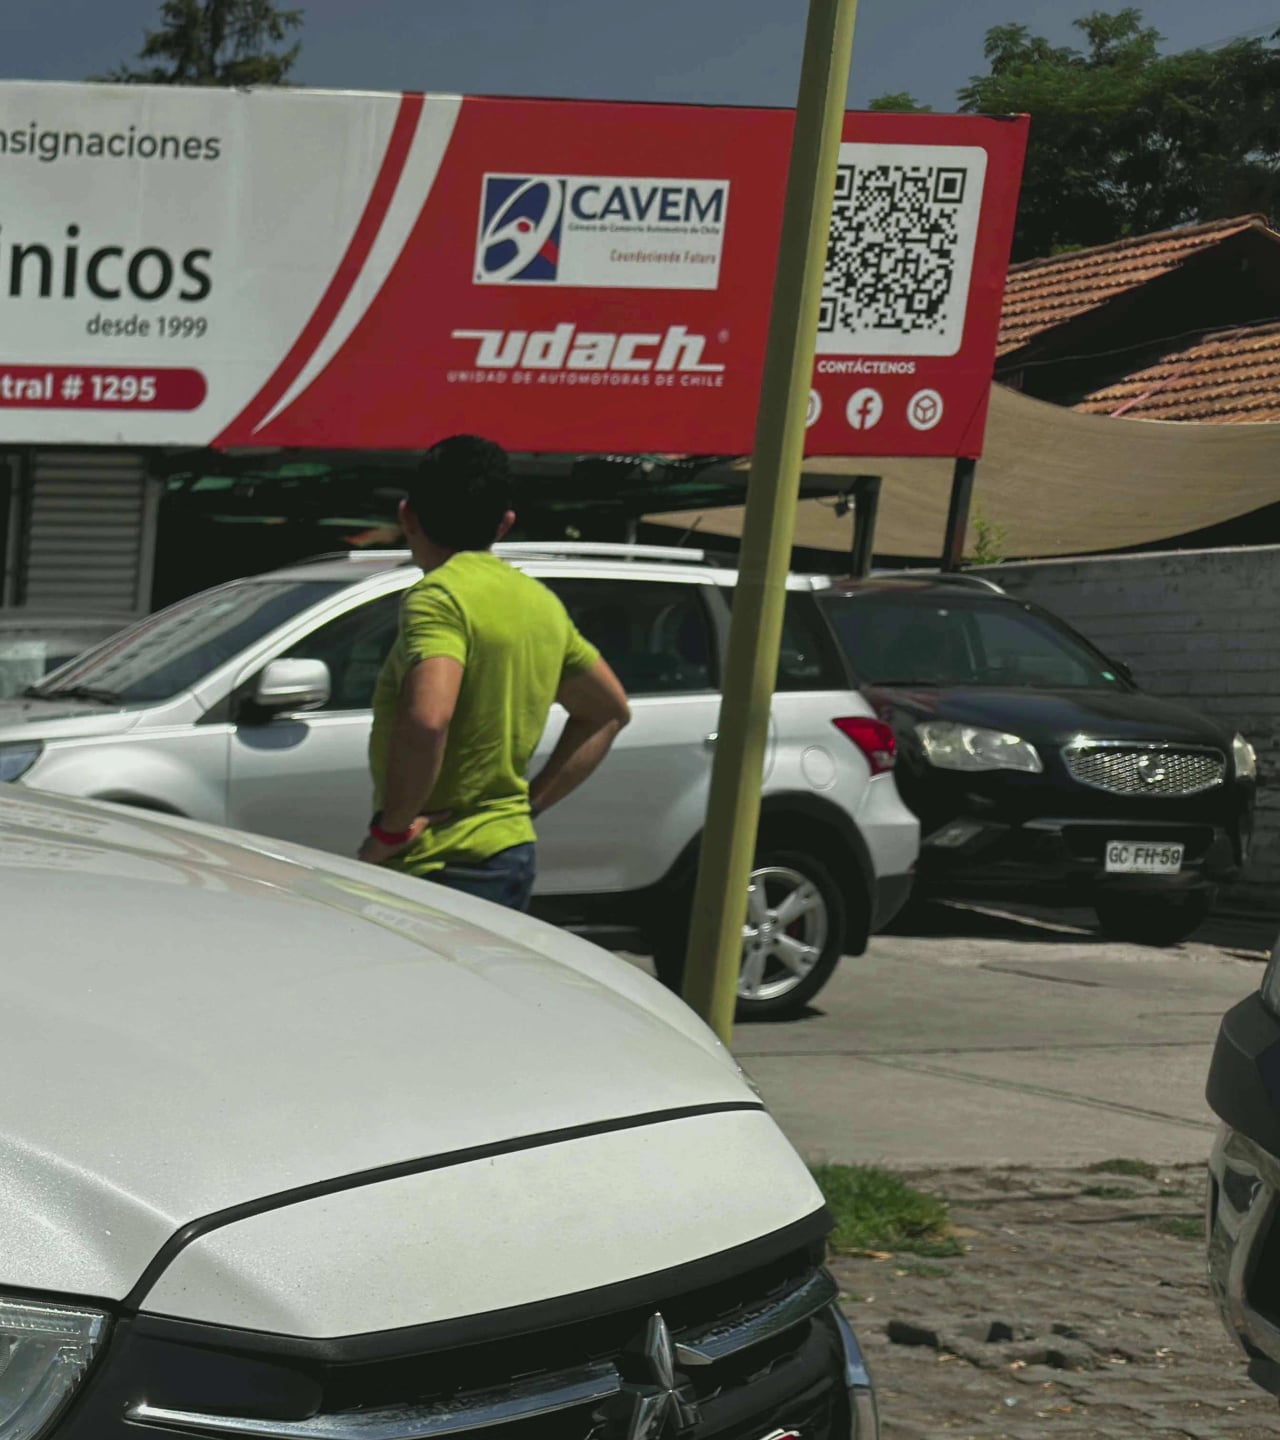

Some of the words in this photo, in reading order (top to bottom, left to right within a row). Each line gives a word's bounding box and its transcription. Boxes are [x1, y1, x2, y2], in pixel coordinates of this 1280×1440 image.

[570, 184, 725, 223] CAVEM
[85, 312, 151, 338] desde
[157, 315, 209, 339] 1999
[450, 322, 726, 372] udach
[446, 370, 507, 384] UNIDAD
[512, 371, 533, 385] DE
[539, 372, 650, 386] AUTOMOTORAS
[654, 373, 674, 387] DE
[679, 373, 724, 388] CHILE
[816, 357, 917, 375] CONTÁCTENOS
[91, 374, 157, 402] 1295
